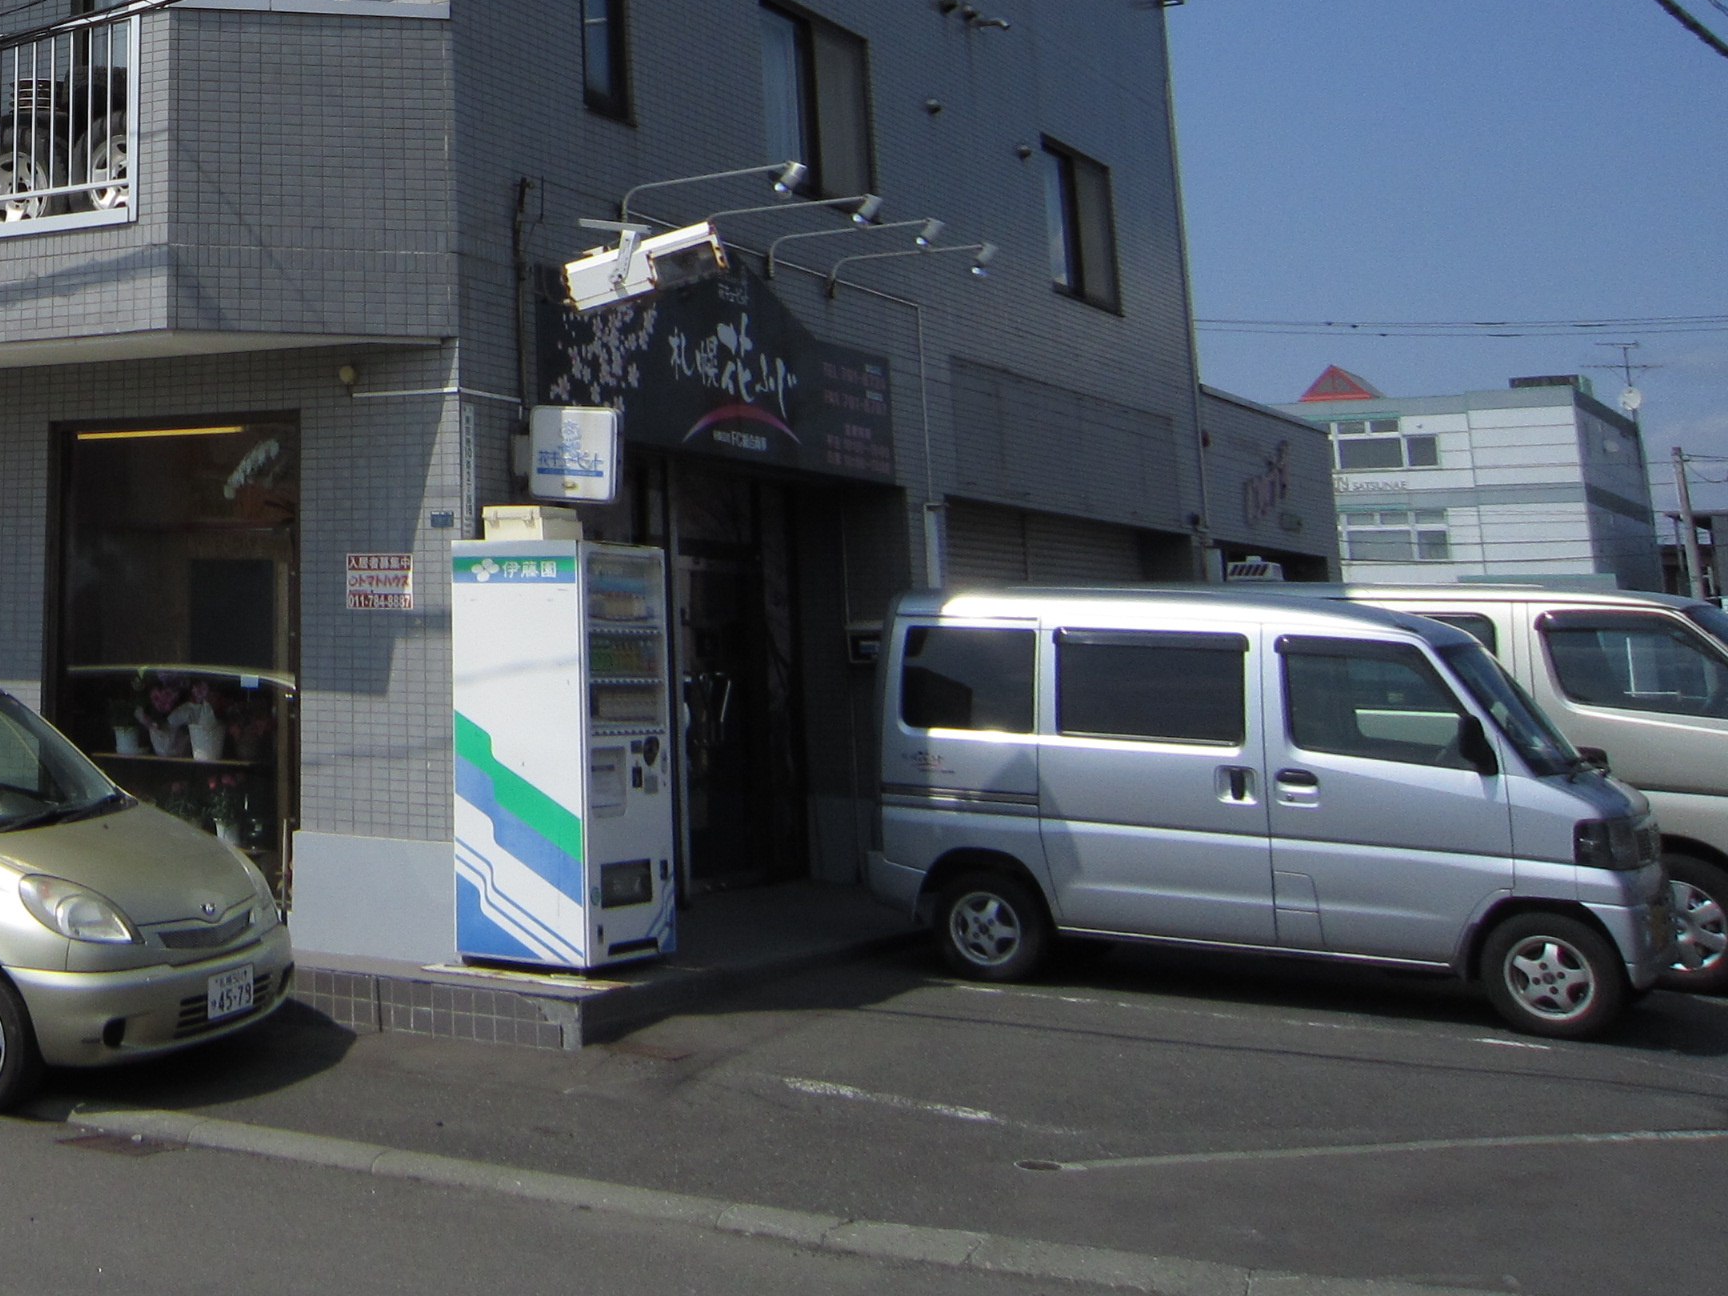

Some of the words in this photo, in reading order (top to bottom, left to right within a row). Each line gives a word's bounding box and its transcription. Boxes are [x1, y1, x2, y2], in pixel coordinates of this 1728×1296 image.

[348, 556, 410, 569] 入居者募集中
[502, 561, 556, 578] 伊藤園
[218, 982, 252, 1012] 45-79
